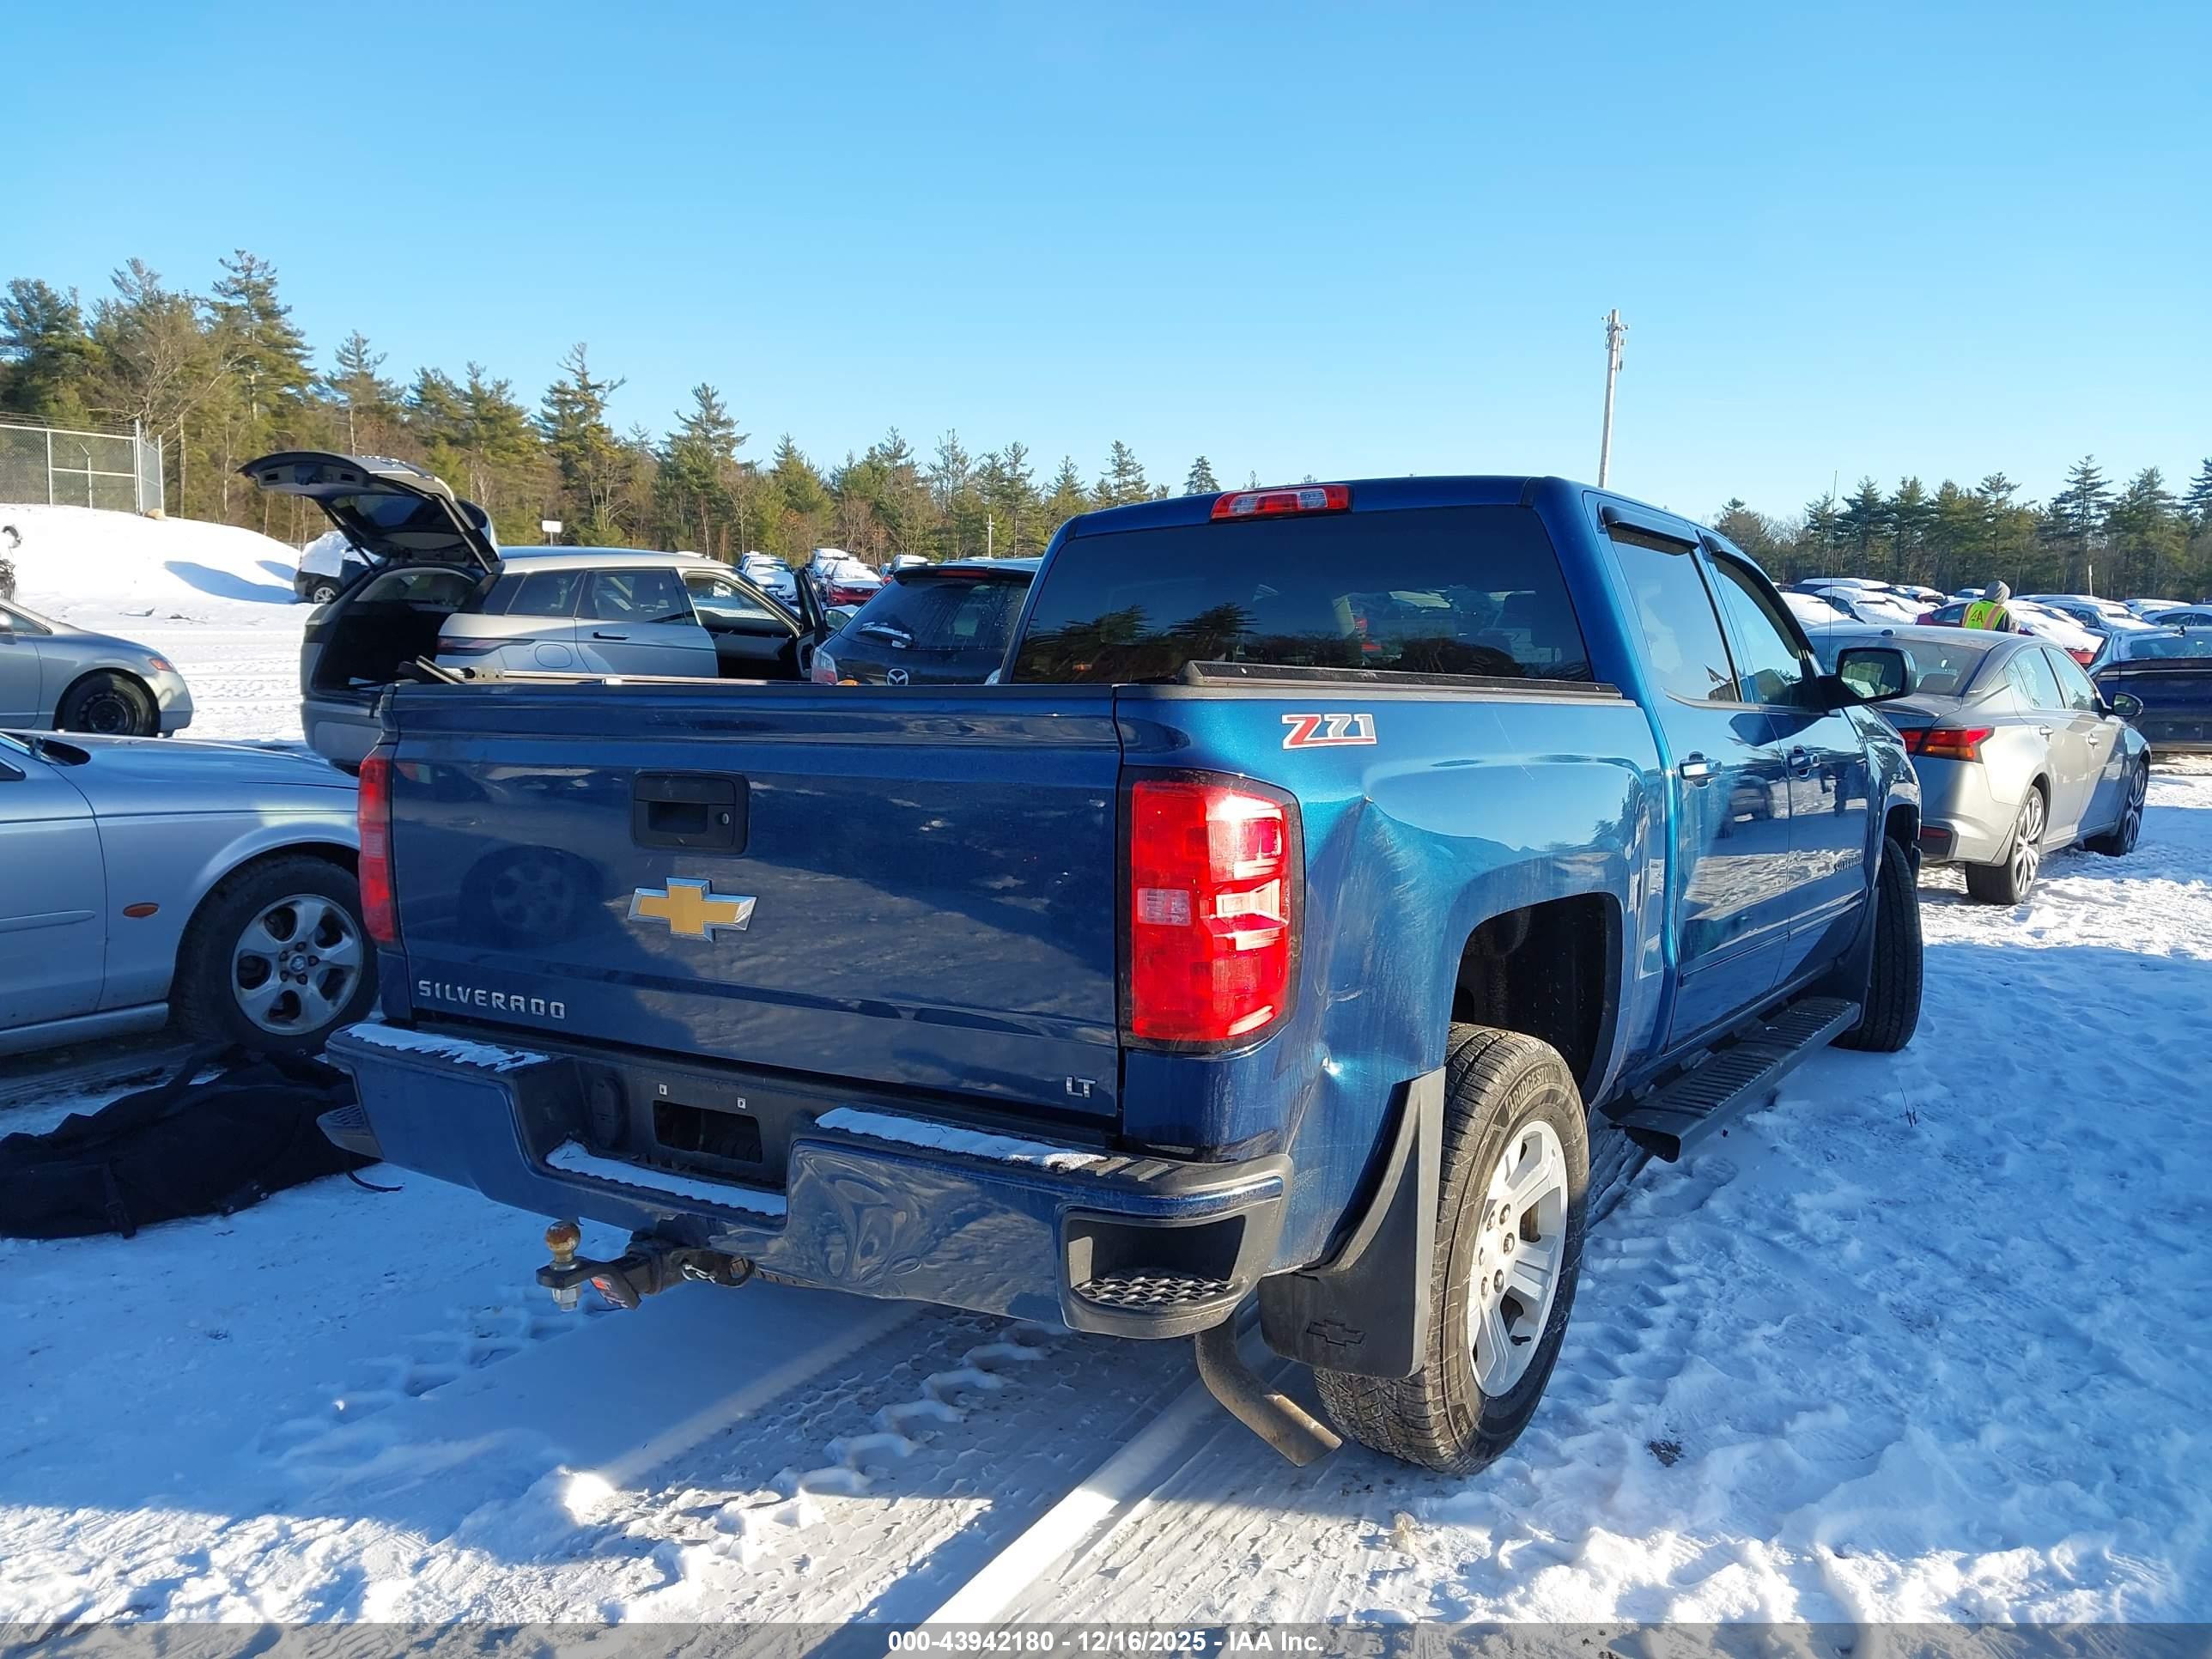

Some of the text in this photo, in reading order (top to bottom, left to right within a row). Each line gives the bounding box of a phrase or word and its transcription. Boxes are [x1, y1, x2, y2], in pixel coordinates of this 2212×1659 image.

[1281, 714, 1377, 750] Z71
[418, 980, 566, 1019] SILVERADO
[1066, 1076, 1097, 1098] LT
